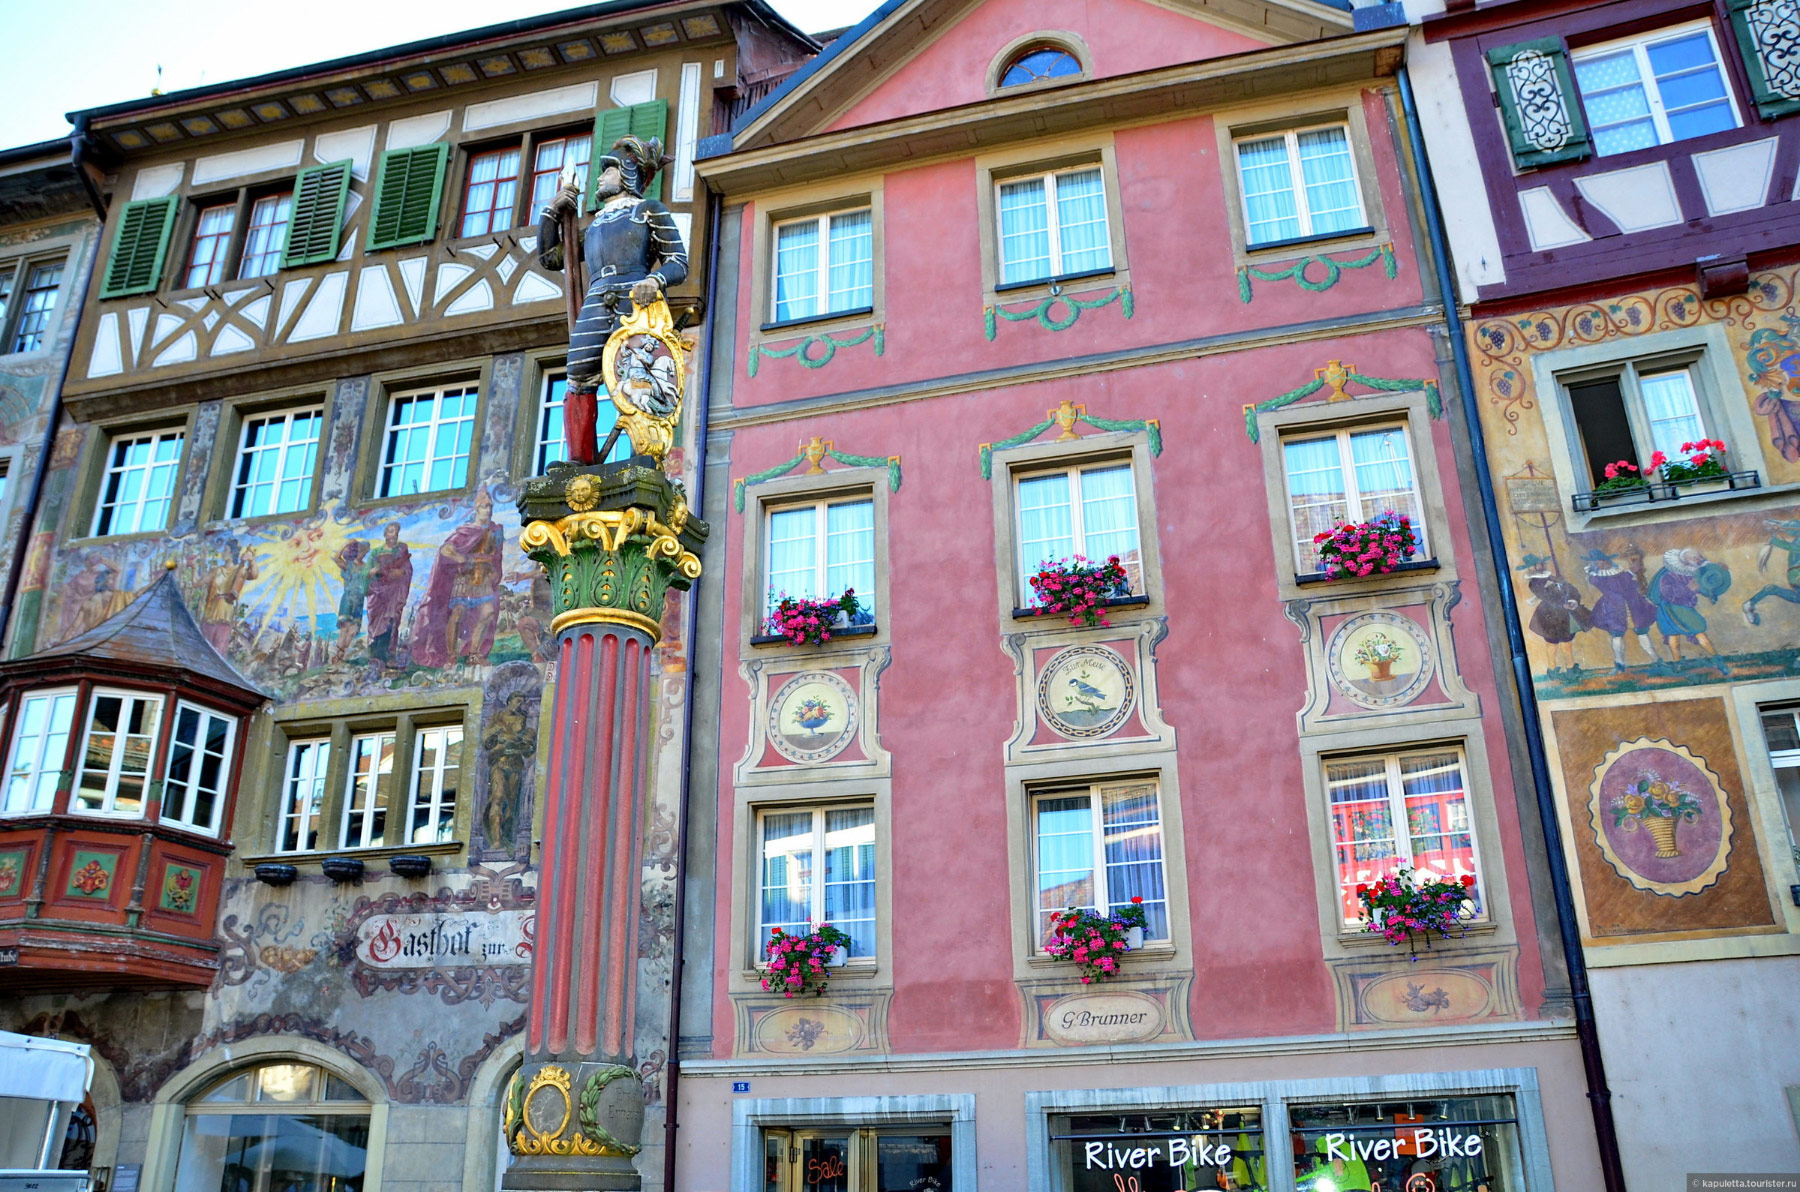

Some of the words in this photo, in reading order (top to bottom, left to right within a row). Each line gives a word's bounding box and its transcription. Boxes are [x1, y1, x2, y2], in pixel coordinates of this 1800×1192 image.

[369, 919, 479, 963] Gasthof
[482, 943, 506, 962] zur
[738, 1083, 745, 1091] 15
[1085, 1142, 1160, 1169] River
[1169, 1138, 1231, 1167] Bike
[1326, 1132, 1406, 1162] River
[1414, 1127, 1482, 1159] Bike
[807, 1155, 844, 1184] Sale
[909, 1177, 926, 1188] River
[928, 1176, 941, 1188] Bike
